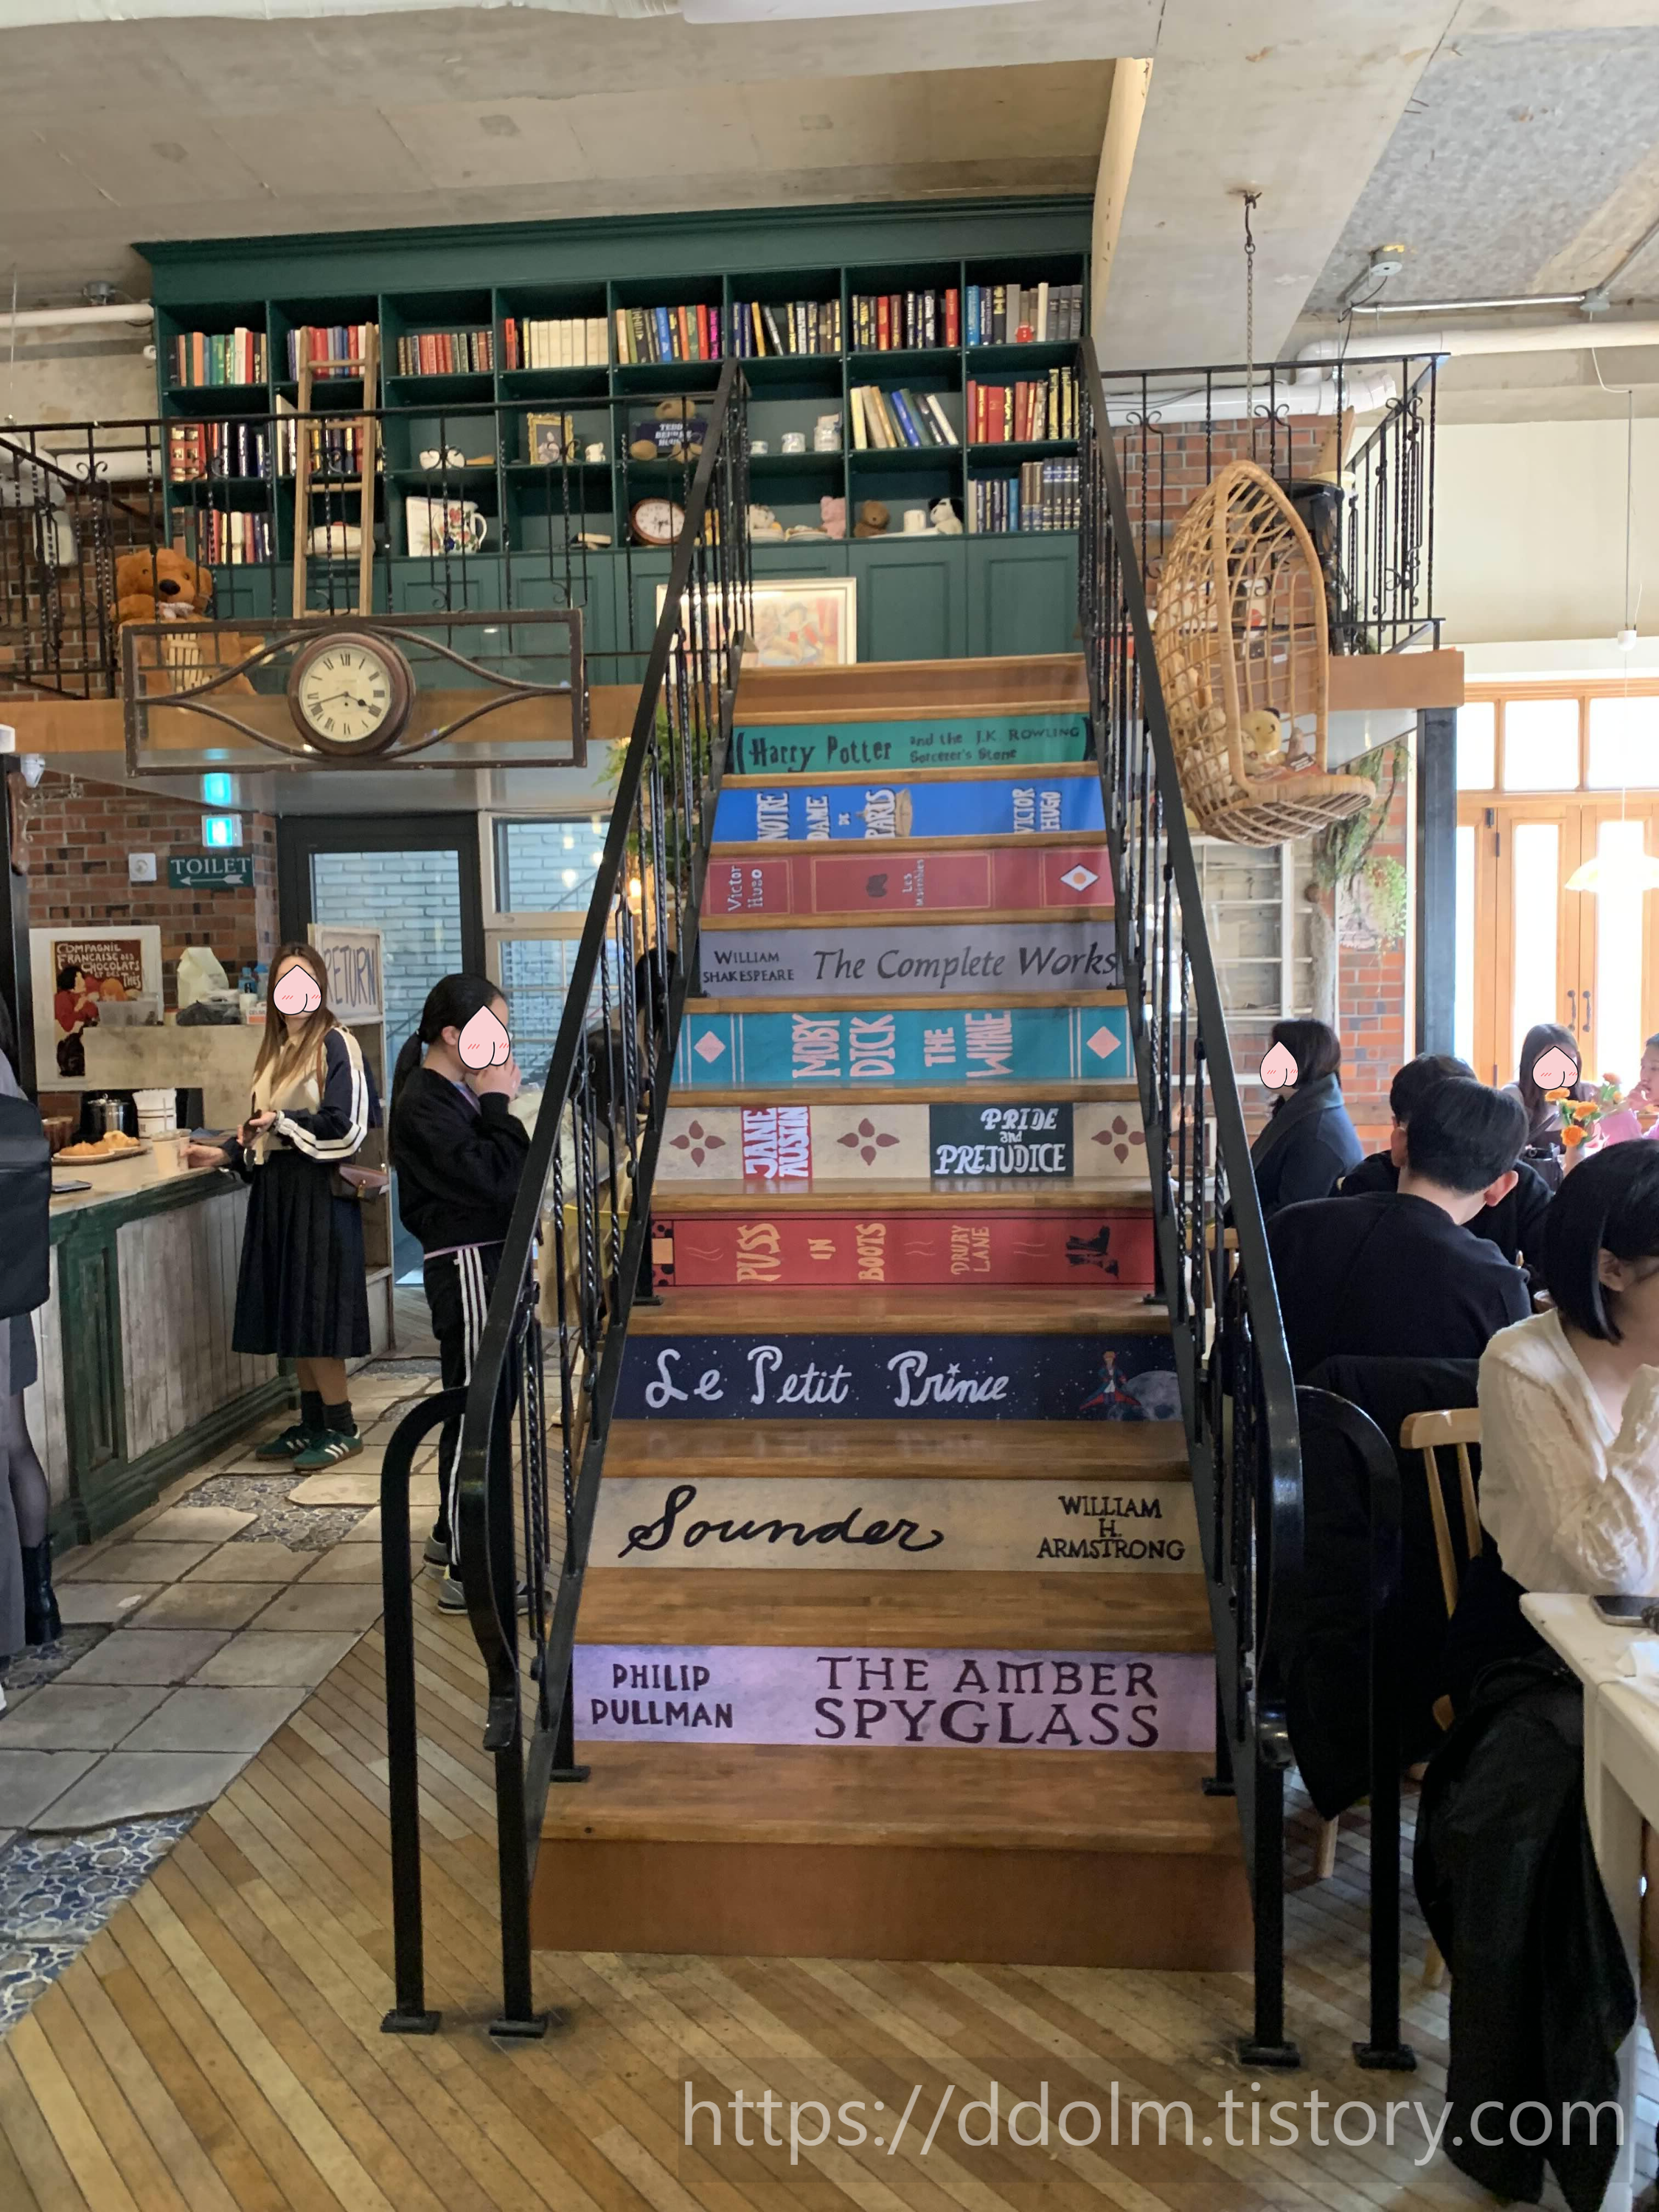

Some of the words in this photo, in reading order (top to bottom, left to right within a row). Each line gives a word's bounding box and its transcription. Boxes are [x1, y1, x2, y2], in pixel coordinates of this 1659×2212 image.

[748, 737, 816, 773] Harry
[827, 735, 891, 765] Potter
[910, 733, 933, 747] and
[939, 732, 963, 745] the
[1009, 726, 1080, 742] ROWLING
[757, 790, 790, 841] NOTRE
[806, 794, 831, 841] DAME
[865, 787, 897, 839] PARIS
[1012, 787, 1036, 834] VICTOR
[1040, 791, 1062, 831] HUGO
[170, 857, 251, 875] TOILET
[727, 865, 743, 912] Victor
[747, 869, 764, 908] Hugo
[81, 961, 140, 974] CHOCOLATS
[323, 945, 377, 1007] RETURN
[703, 969, 794, 984] SHAKESPEARE
[713, 950, 780, 964] WILLIAM
[813, 948, 866, 981] The
[877, 945, 1006, 990] Complete
[1018, 941, 1119, 976] Works
[791, 1013, 841, 1079] MOBY
[849, 1014, 896, 1077] DICK
[923, 1026, 956, 1068] THE
[964, 1010, 1014, 1078] WHALE
[980, 1107, 1060, 1131] PRIDE
[998, 1130, 1023, 1144] and
[742, 1107, 779, 1179] JANE
[933, 1143, 1067, 1175] PREJUDICE
[736, 1222, 782, 1283] PUSS
[807, 1238, 836, 1260] IN
[855, 1222, 887, 1282] BOOTS
[950, 1225, 970, 1276] DRURY
[971, 1226, 992, 1273] LANE
[645, 1348, 724, 1408] Le
[747, 1345, 852, 1405] Petit
[887, 1349, 1009, 1408] Prince
[618, 1484, 945, 1559] Sounder
[1058, 1495, 1163, 1519] WILLIAM
[1098, 1517, 1122, 1539] H.
[1036, 1537, 1186, 1562] ARMSTRONG
[612, 1662, 711, 1688] PHILIP
[815, 1655, 929, 1692] THE
[952, 1659, 1158, 1699] AMBER
[591, 1697, 734, 1728] PULLMAN
[813, 1697, 1160, 1747] SPYGLASS
